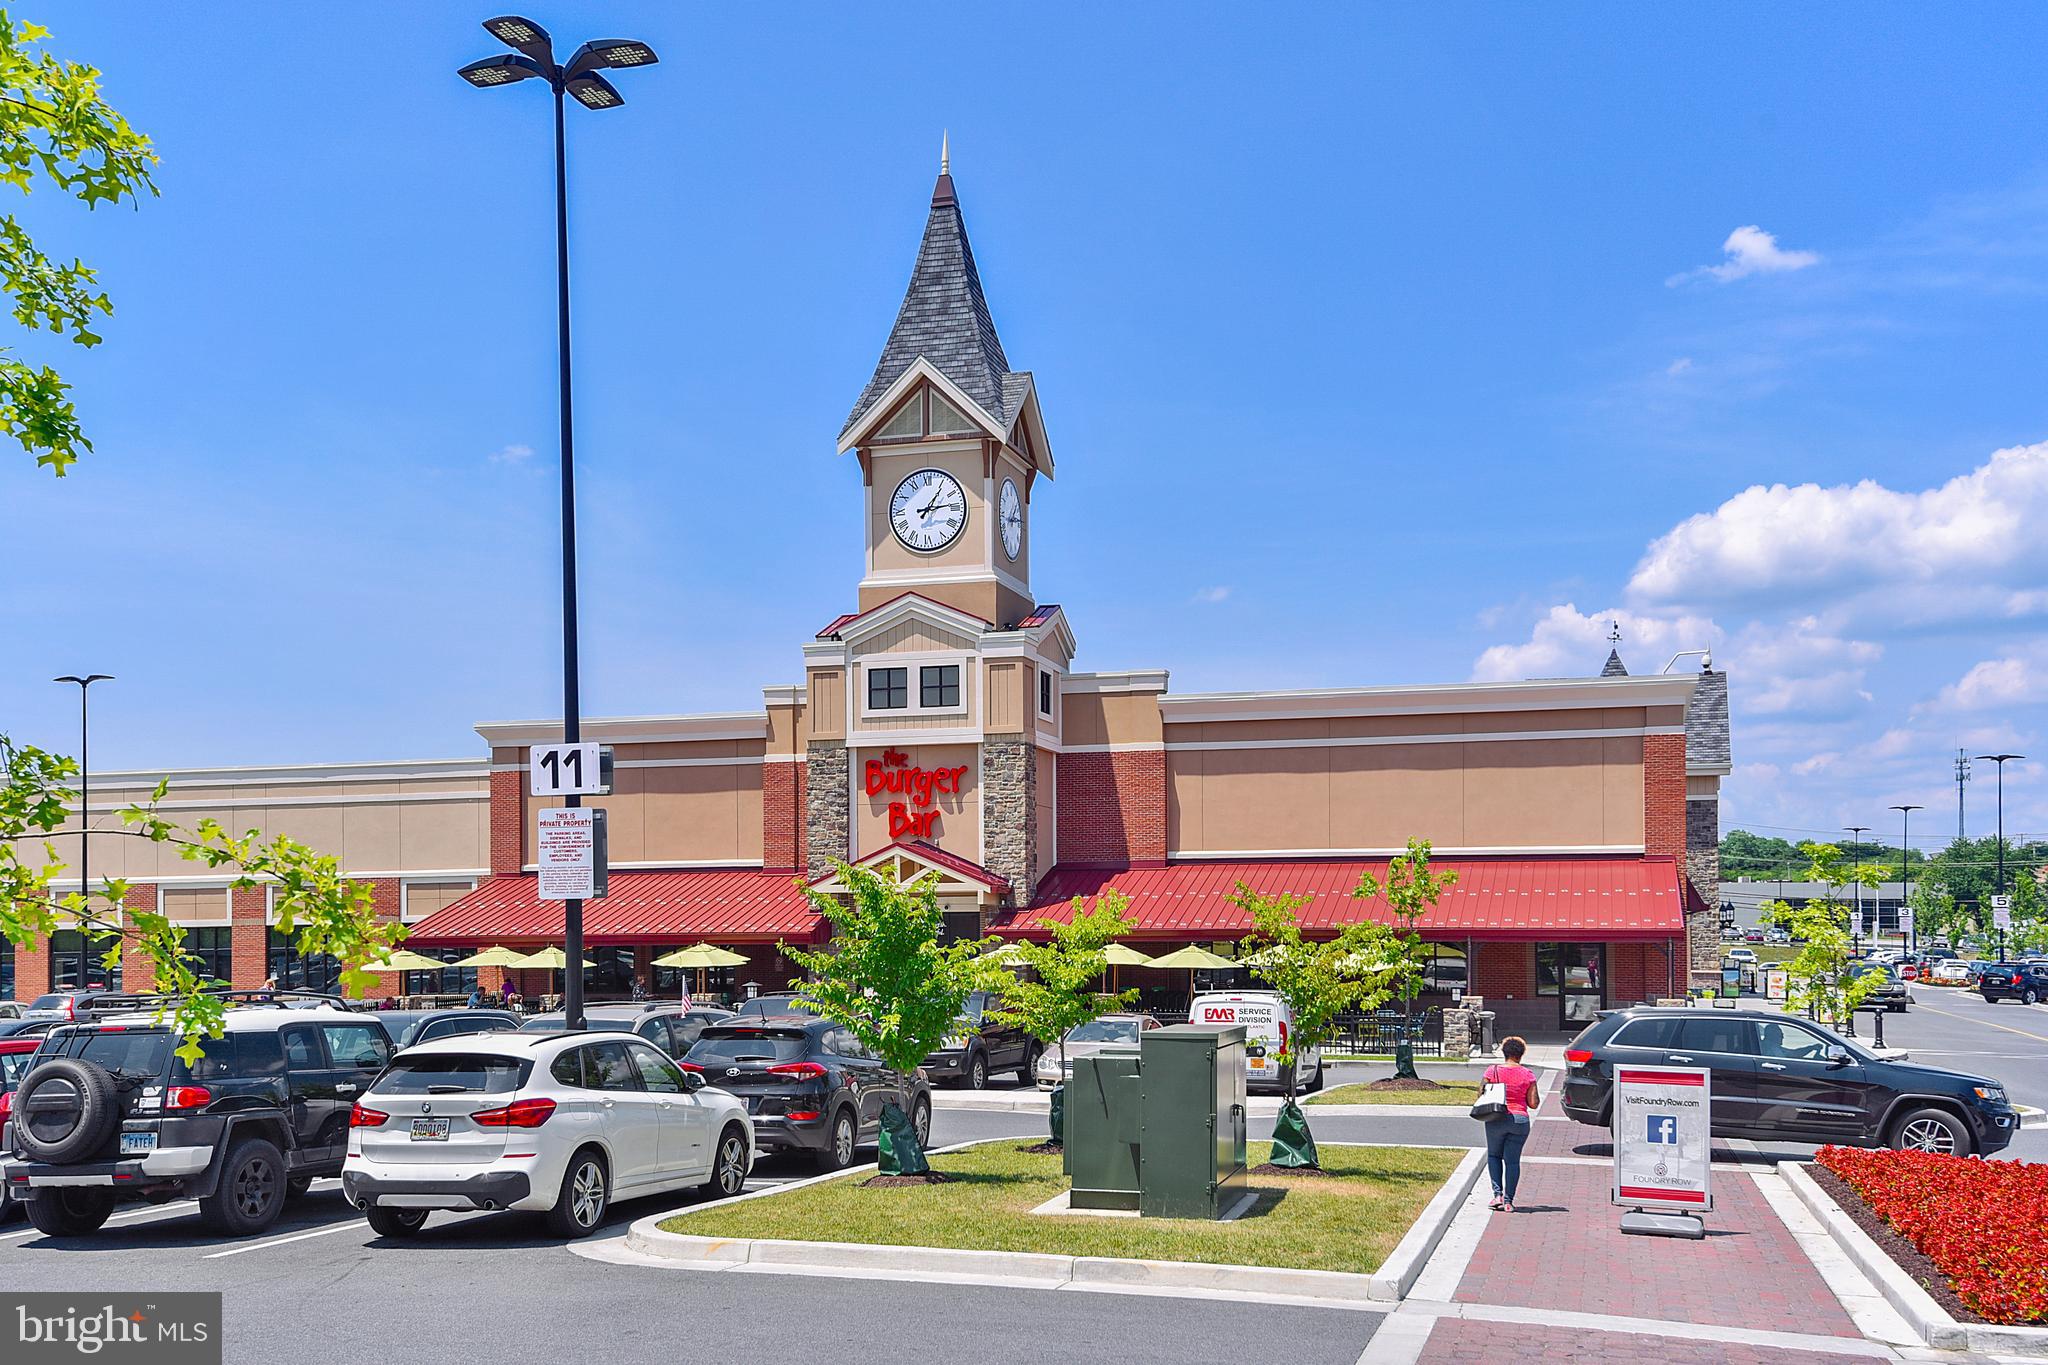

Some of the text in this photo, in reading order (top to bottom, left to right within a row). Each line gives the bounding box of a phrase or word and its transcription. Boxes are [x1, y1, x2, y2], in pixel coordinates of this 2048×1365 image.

[883, 746, 909, 768] the
[540, 749, 582, 789] 11
[865, 759, 969, 807] Burger
[888, 801, 941, 839] Bar
[1997, 896, 2007, 906] 5
[1901, 908, 1909, 916] 3
[1239, 1008, 1272, 1016] SERVICE
[1625, 1096, 1700, 1108] VisitFoundryRow.com
[1633, 1175, 1692, 1186] FOUNDRY ROW
